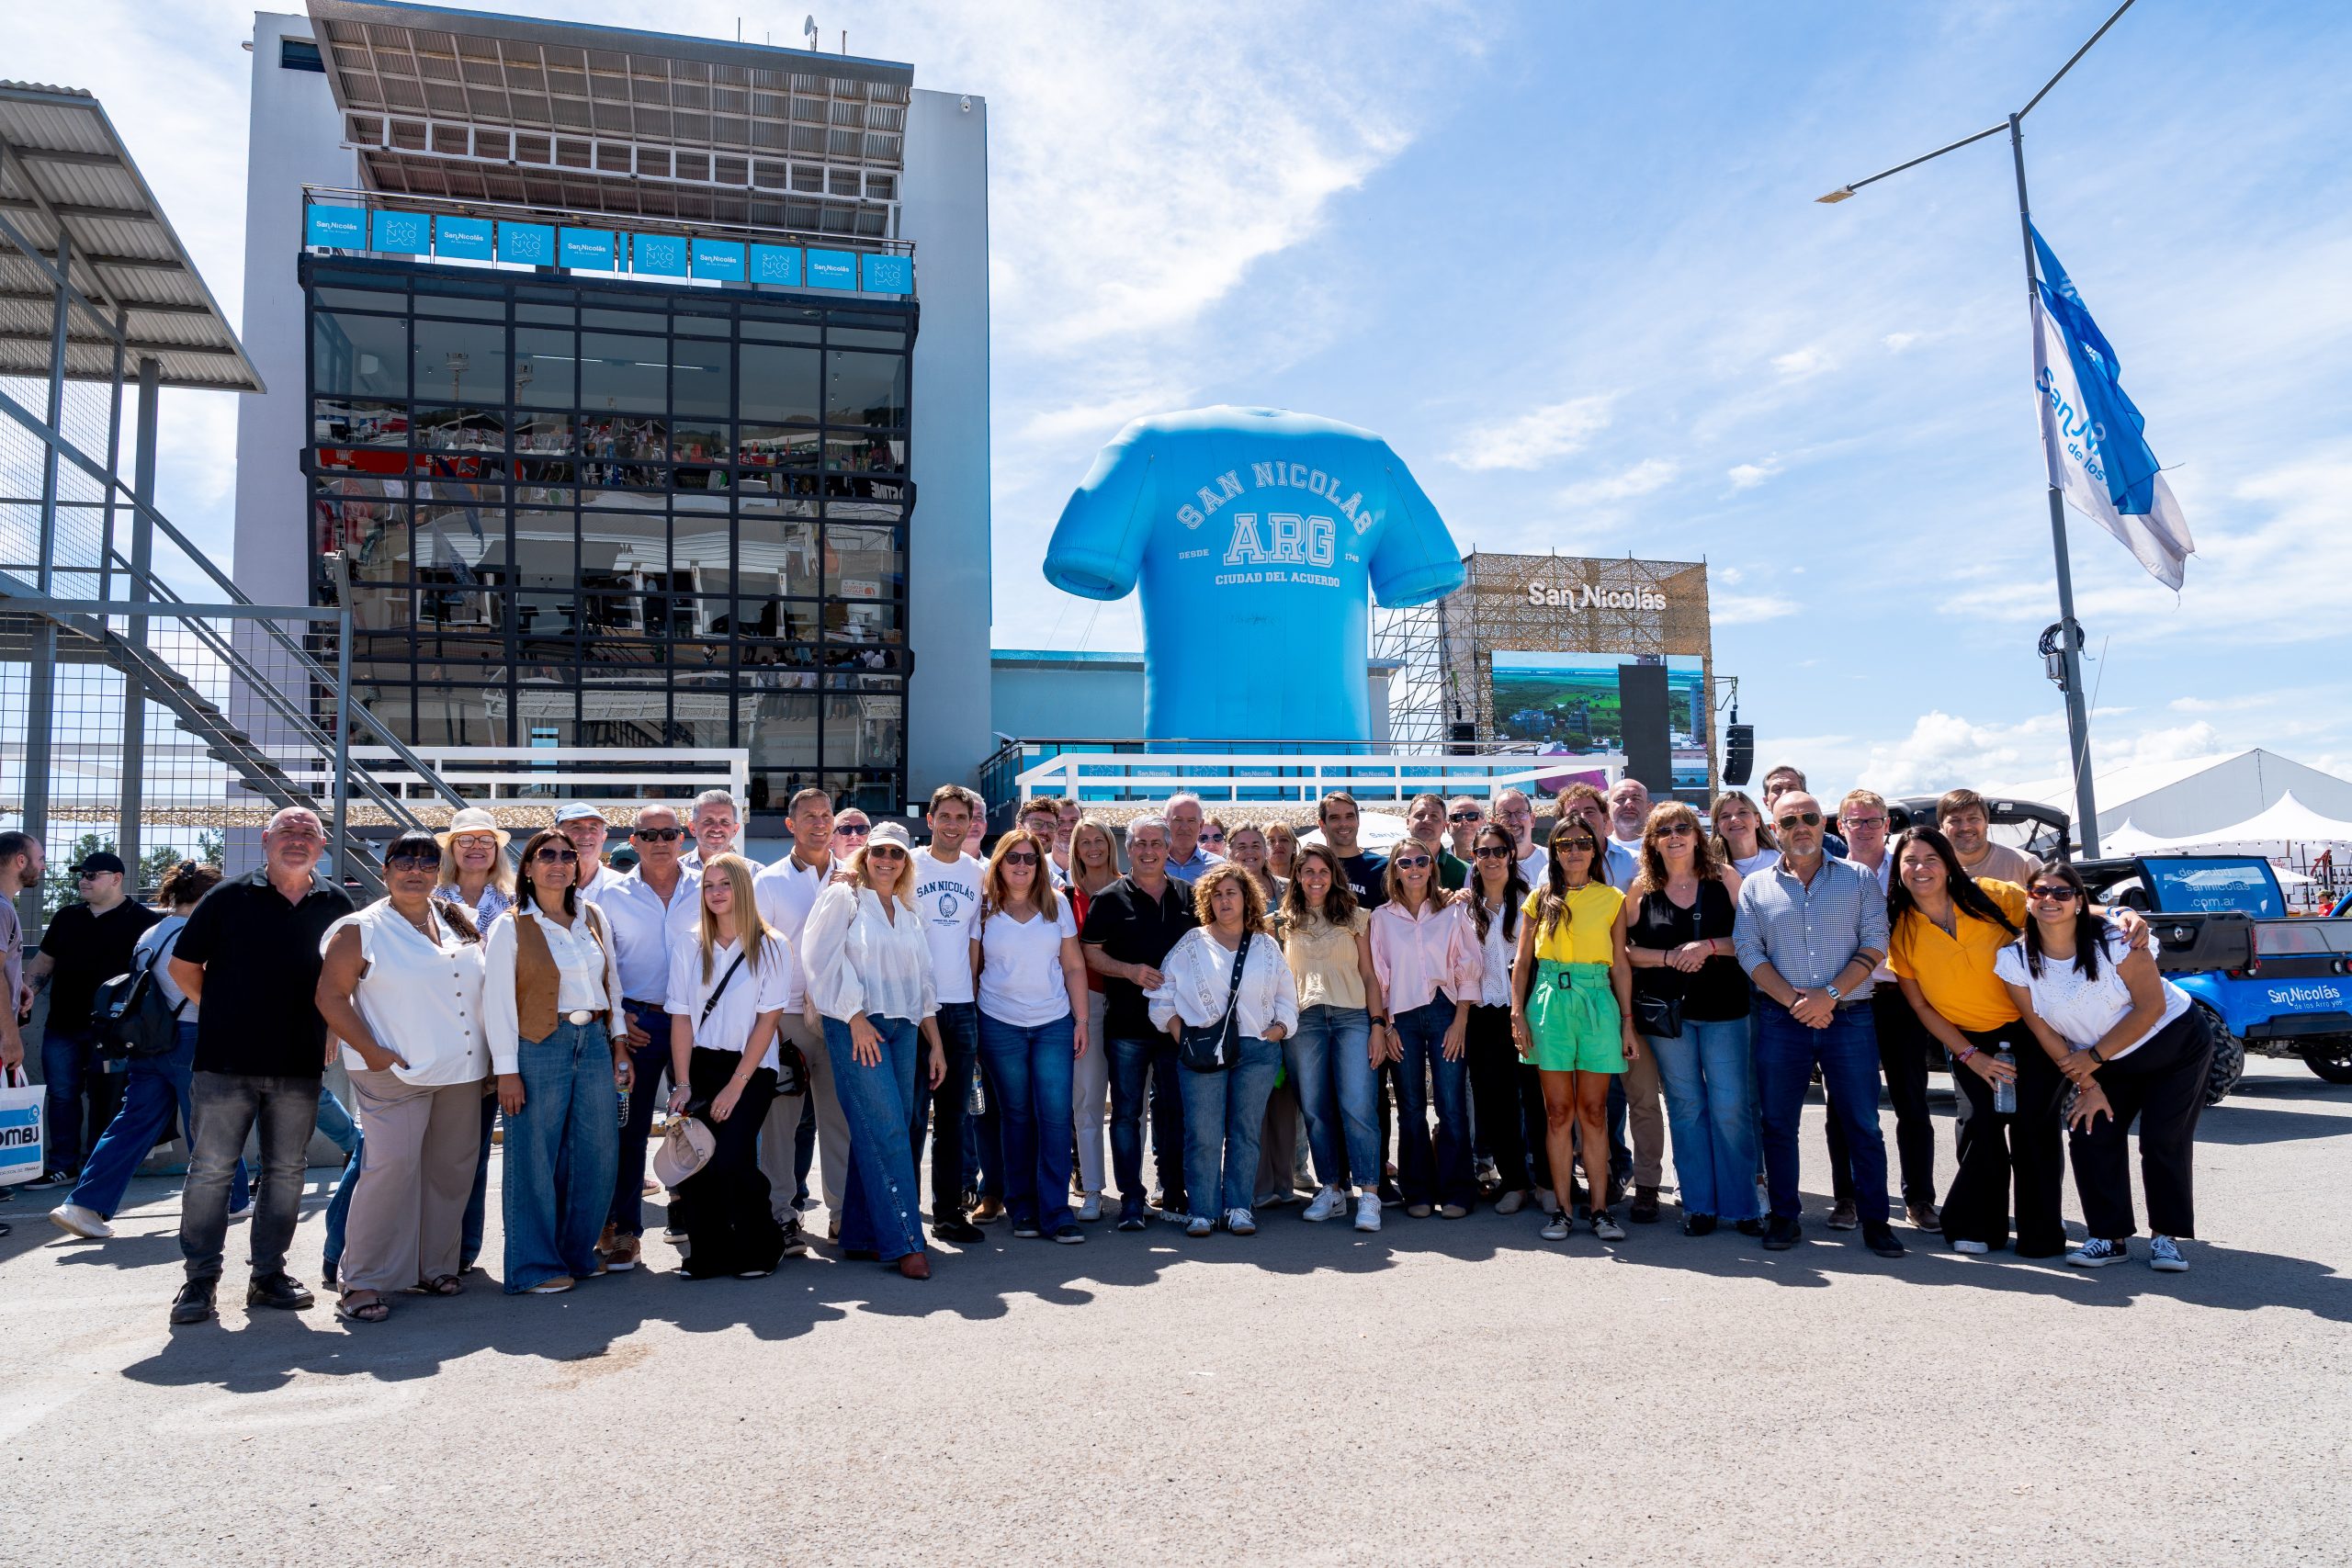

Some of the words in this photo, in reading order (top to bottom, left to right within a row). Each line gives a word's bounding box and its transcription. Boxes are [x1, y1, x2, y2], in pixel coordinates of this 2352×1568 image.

[317, 221, 330, 229] San
[444, 232, 458, 240] San
[568, 243, 581, 252] San
[2037, 366, 2074, 437] San
[2067, 441, 2083, 461] de
[2084, 457, 2105, 481] los
[1176, 470, 1244, 530] SAN
[1251, 461, 1372, 536] NICOLÁS
[1223, 513, 1335, 568] ARG
[1179, 549, 1210, 559] DESDE
[1345, 553, 1359, 563] 1748
[1215, 572, 1262, 585] CIUDAD
[1265, 571, 1287, 582] DEL
[1291, 572, 1340, 587] ACUERDO
[1528, 582, 1579, 615] San
[1580, 583, 1666, 611] Nicolás
[917, 882, 936, 897] SAN
[938, 881, 974, 901] NICOLÁS
[1348, 883, 1366, 895] INA
[2186, 880, 2250, 892] sannicolas
[2190, 897, 2235, 908] .com.ar
[2267, 989, 2293, 1006] San
[2290, 985, 2340, 1002] Nicolás
